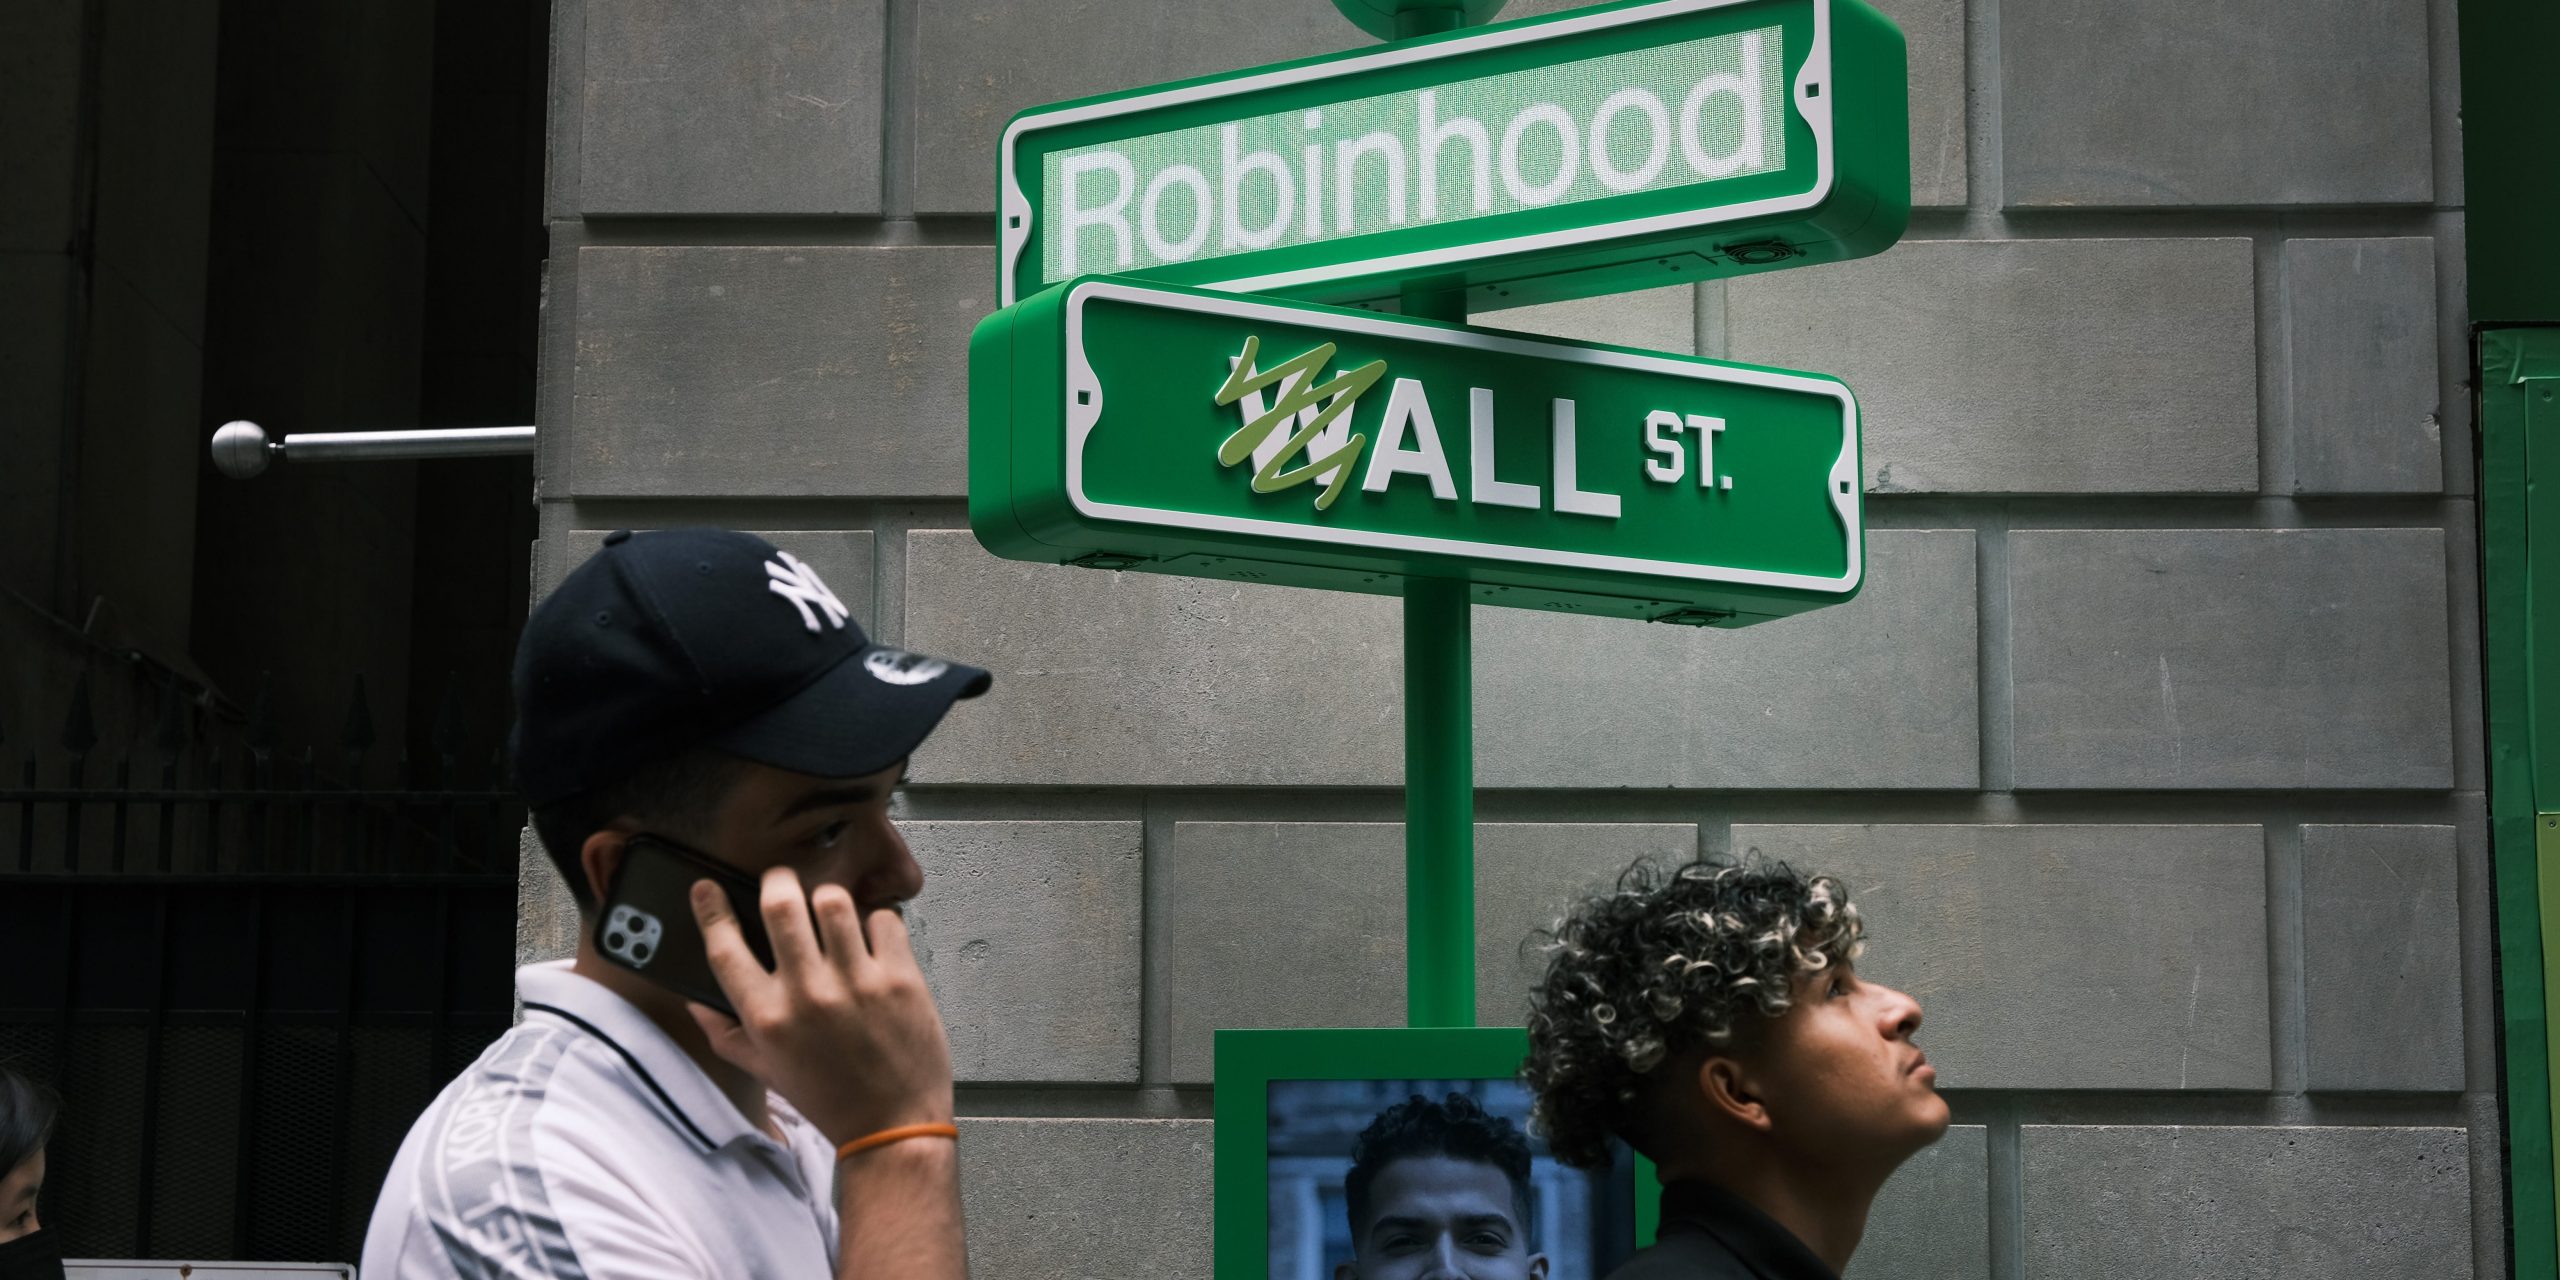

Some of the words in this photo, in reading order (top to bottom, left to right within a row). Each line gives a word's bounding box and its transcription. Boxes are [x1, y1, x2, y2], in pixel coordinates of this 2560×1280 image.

[1060, 32, 1766, 278] Robinhood
[1230, 354, 1622, 519] WALL
[1642, 410, 1734, 491] ST.
